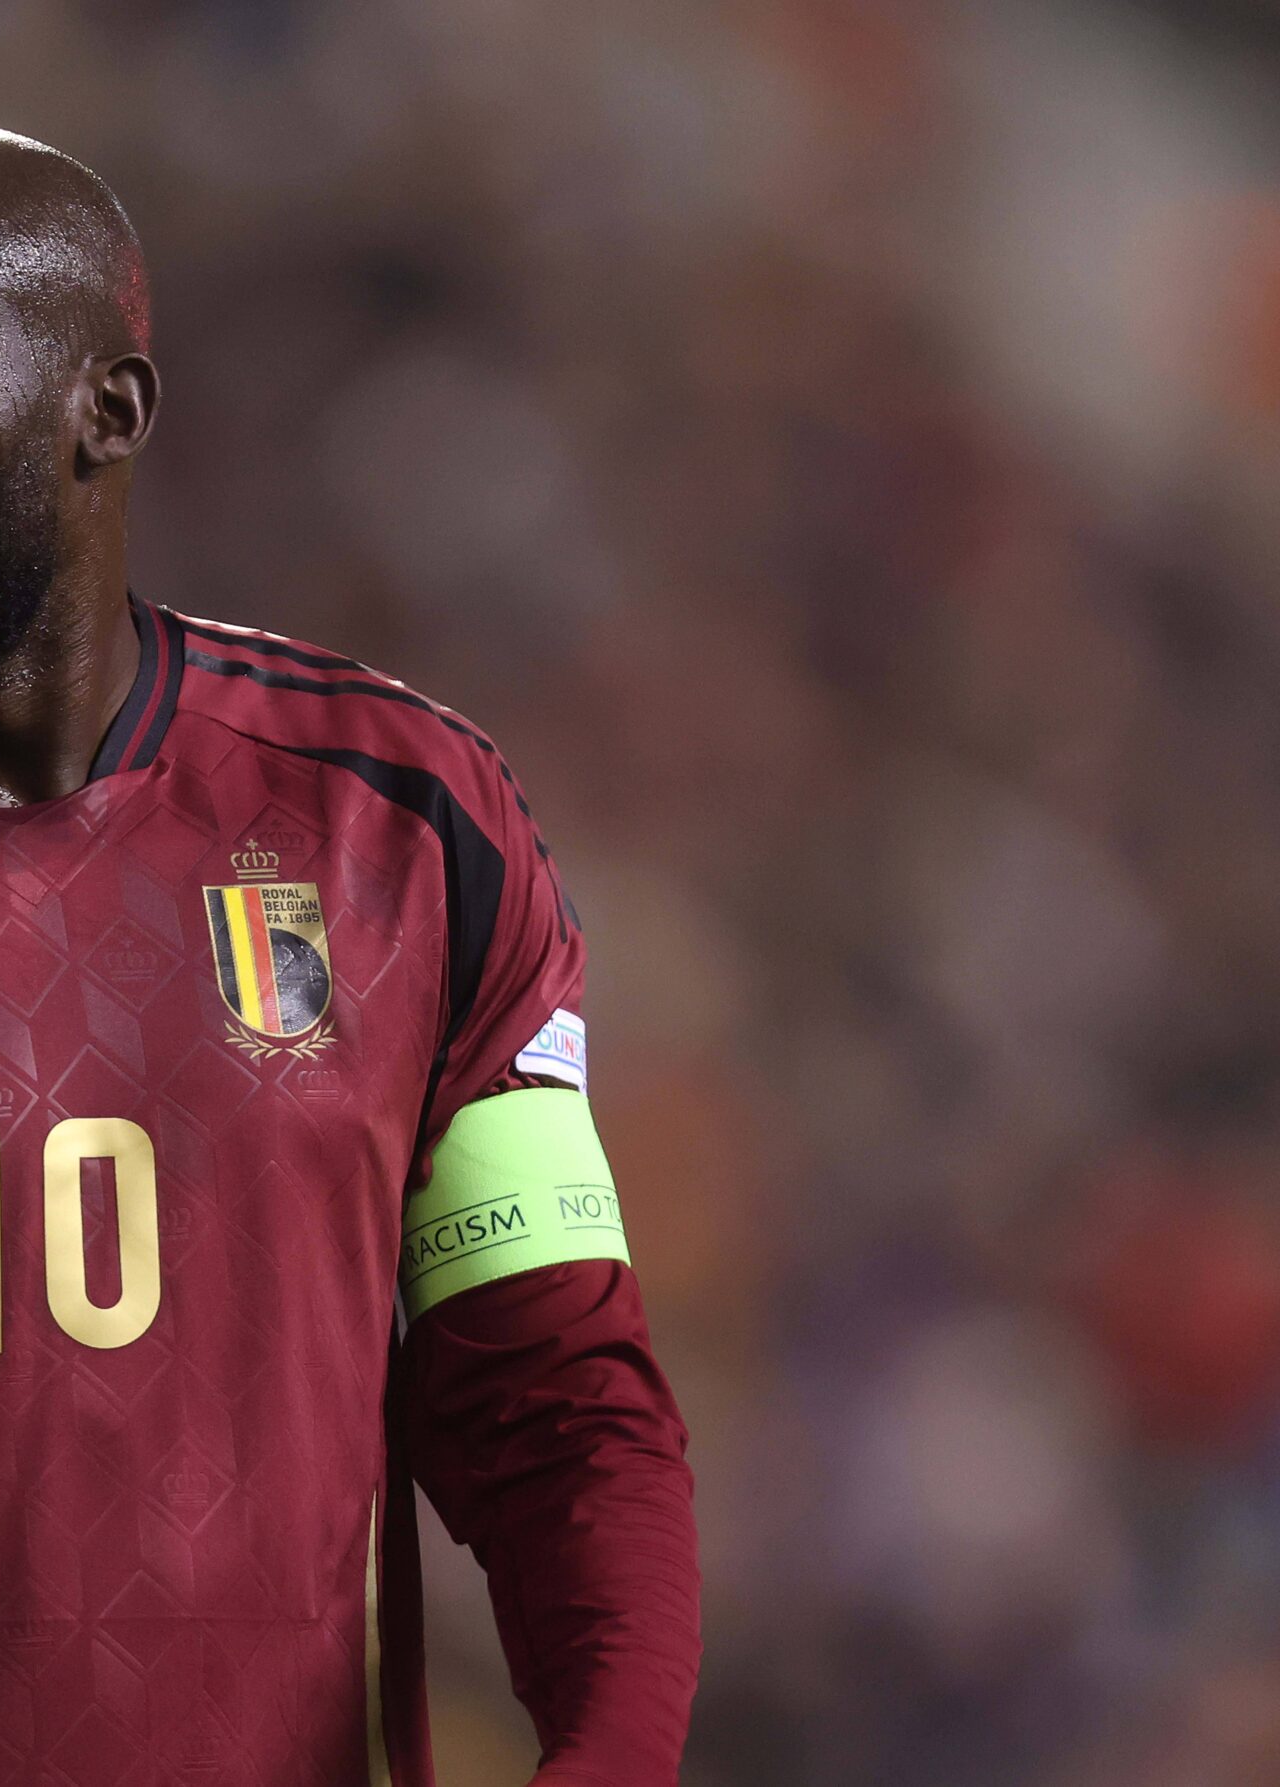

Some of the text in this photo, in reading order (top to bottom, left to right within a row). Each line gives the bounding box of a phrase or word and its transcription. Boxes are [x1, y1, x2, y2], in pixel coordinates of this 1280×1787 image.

[261, 888, 302, 899] ROYAL
[264, 900, 318, 911] BELGIAN
[266, 912, 320, 923] FA 1895
[558, 1193, 601, 1220] NO
[405, 1203, 526, 1268] RACISM
